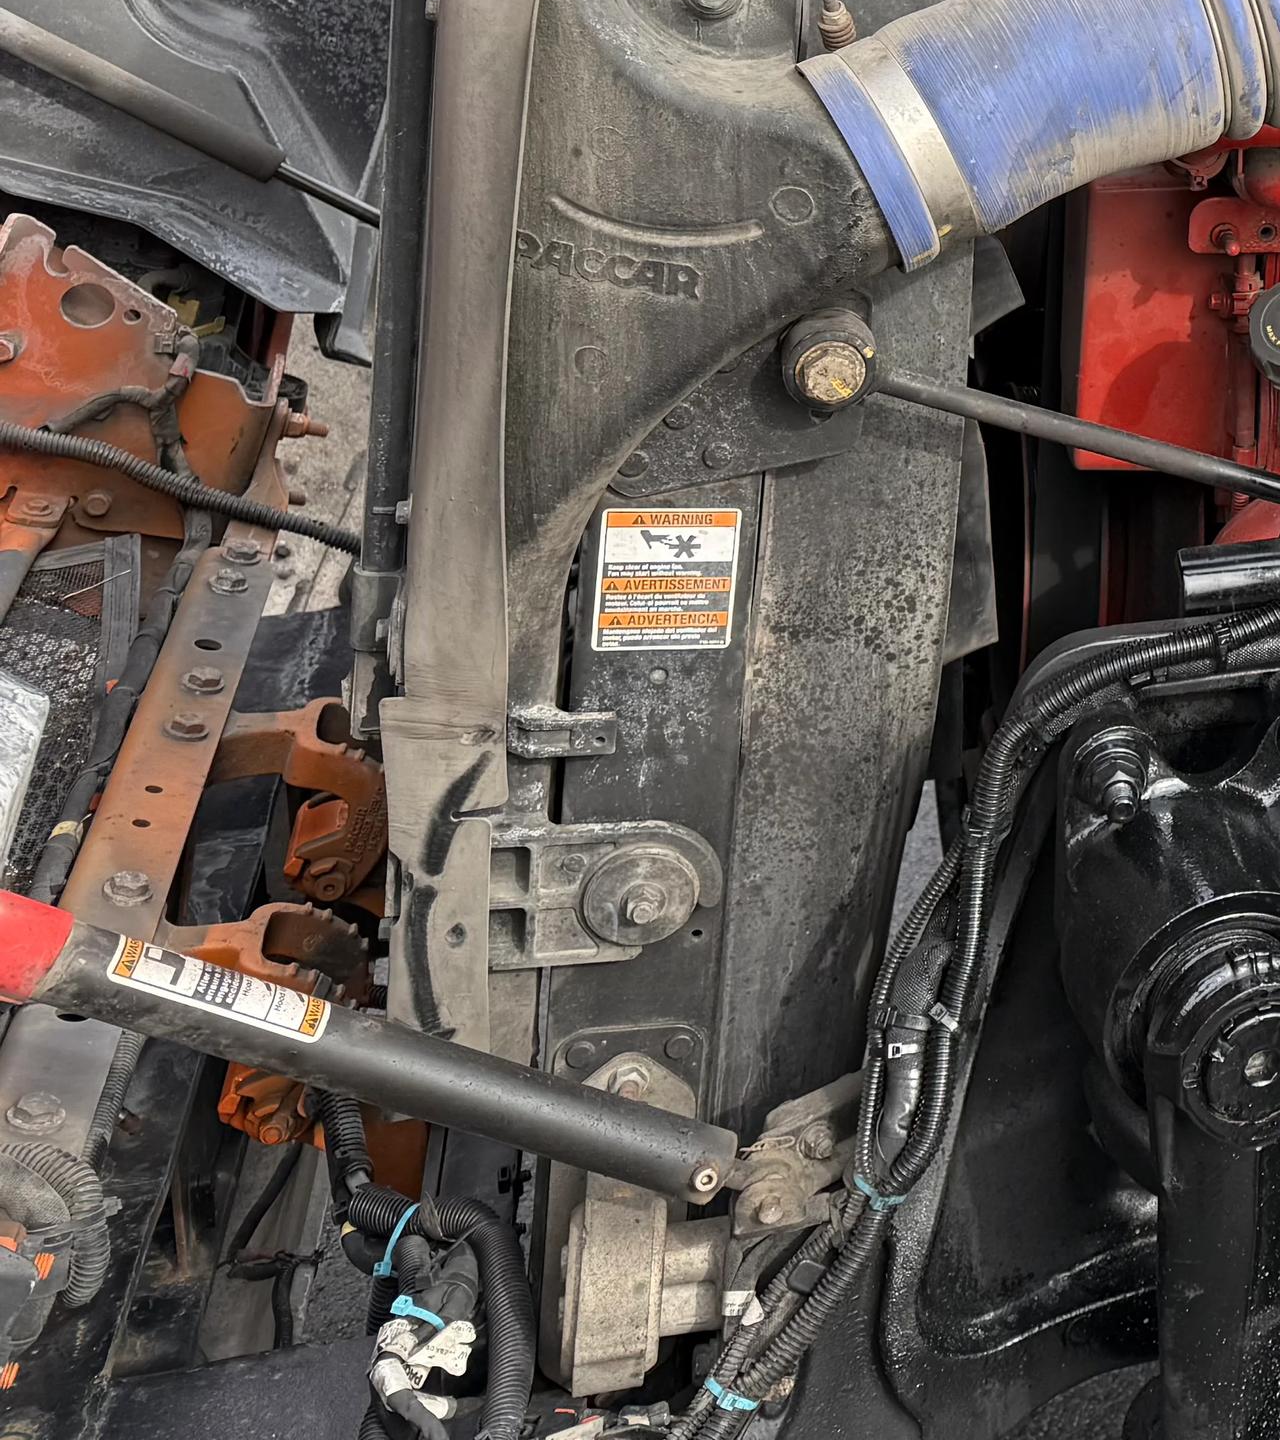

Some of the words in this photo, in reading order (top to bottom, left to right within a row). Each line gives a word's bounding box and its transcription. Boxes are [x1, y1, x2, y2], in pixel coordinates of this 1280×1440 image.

[516, 229, 702, 302] PACCAR
[1266, 325, 1277, 342] MAX
[650, 514, 713, 525] WARNING
[624, 579, 728, 591] AVERTISSEMENT
[627, 614, 719, 626] ADVERTENCIA
[196, 970, 211, 994] After
[205, 971, 221, 1002] ensure
[241, 978, 255, 997] Hood
[273, 991, 287, 1012] Hood
